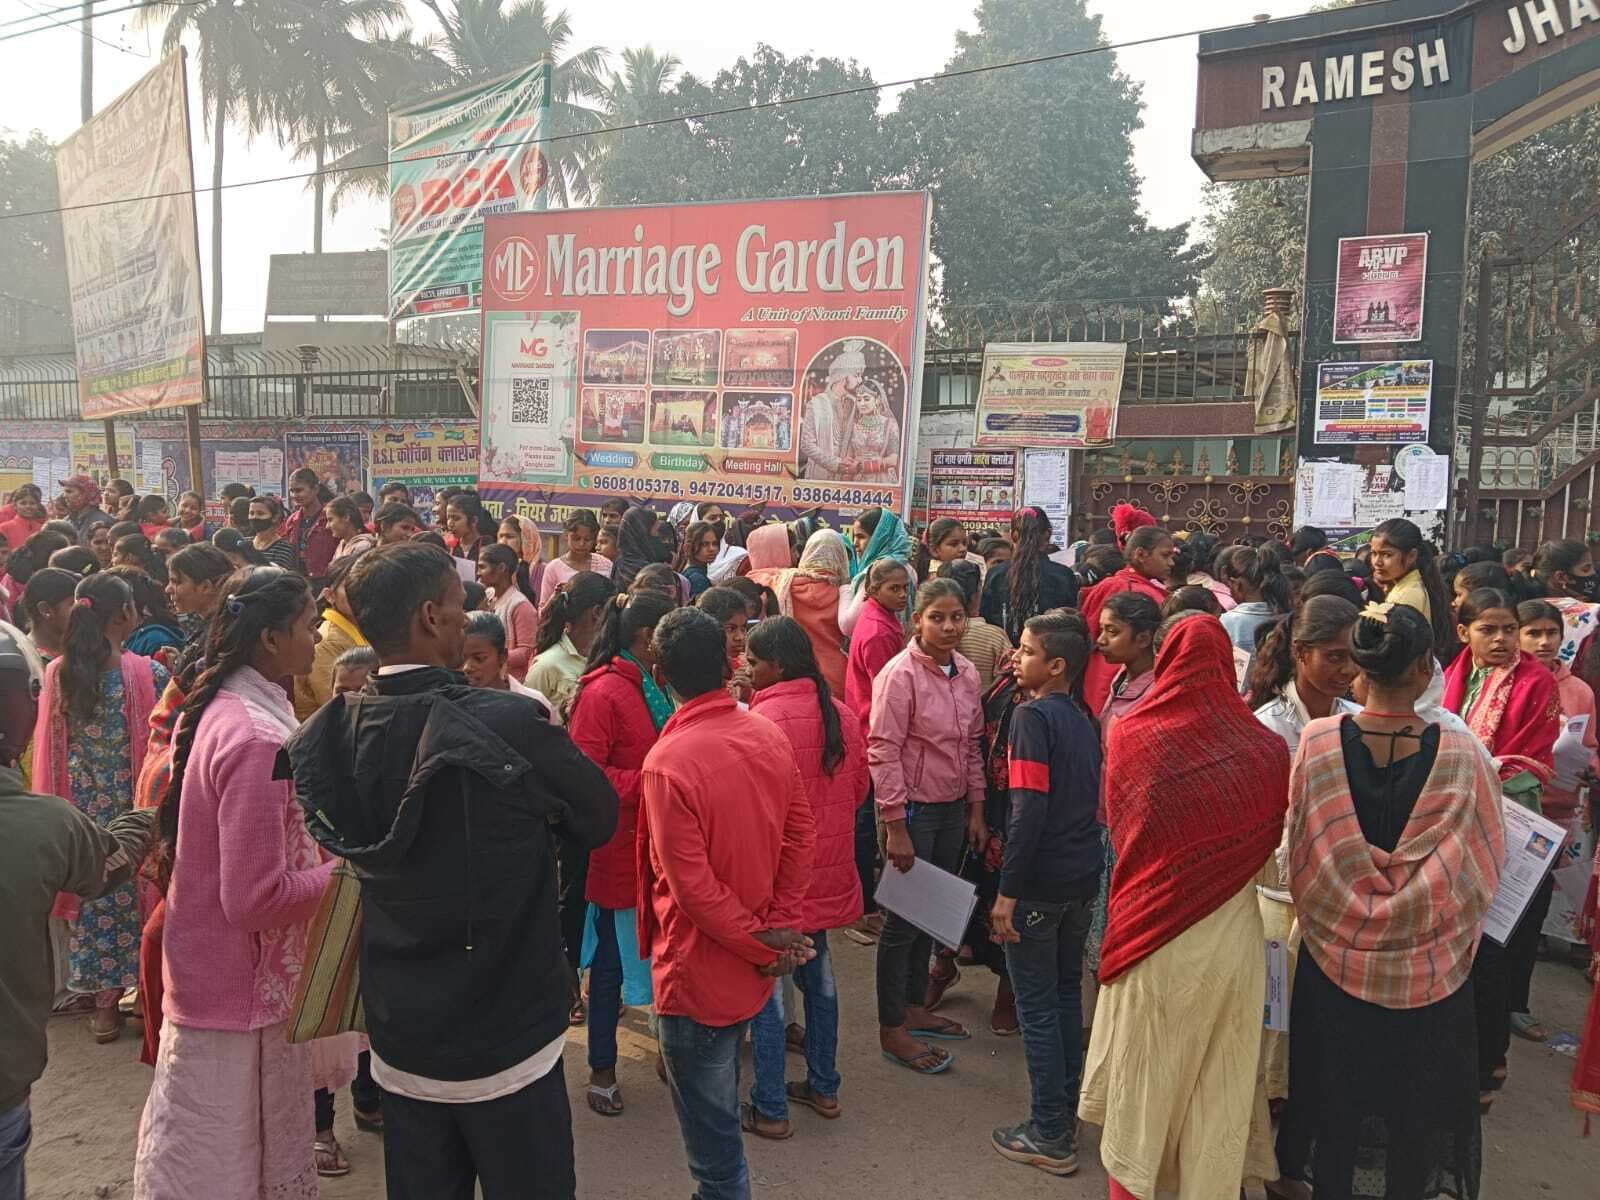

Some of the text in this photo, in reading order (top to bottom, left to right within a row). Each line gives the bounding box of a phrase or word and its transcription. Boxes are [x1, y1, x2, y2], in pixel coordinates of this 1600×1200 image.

[1261, 38, 1450, 110] RAMESH
[494, 241, 535, 295] MG
[544, 223, 722, 317] Marriage
[736, 220, 905, 294] Garden
[740, 305, 908, 325] A Unit of Noori Family
[520, 337, 548, 357] MG
[397, 441, 432, 464] कोचिंग
[591, 453, 634, 465] Wedding
[660, 455, 705, 470] Birthday
[725, 459, 761, 473] Meeting
[593, 475, 684, 496] 9608105378,
[689, 480, 787, 503] 9472041517,
[792, 487, 894, 507] 9386448444
